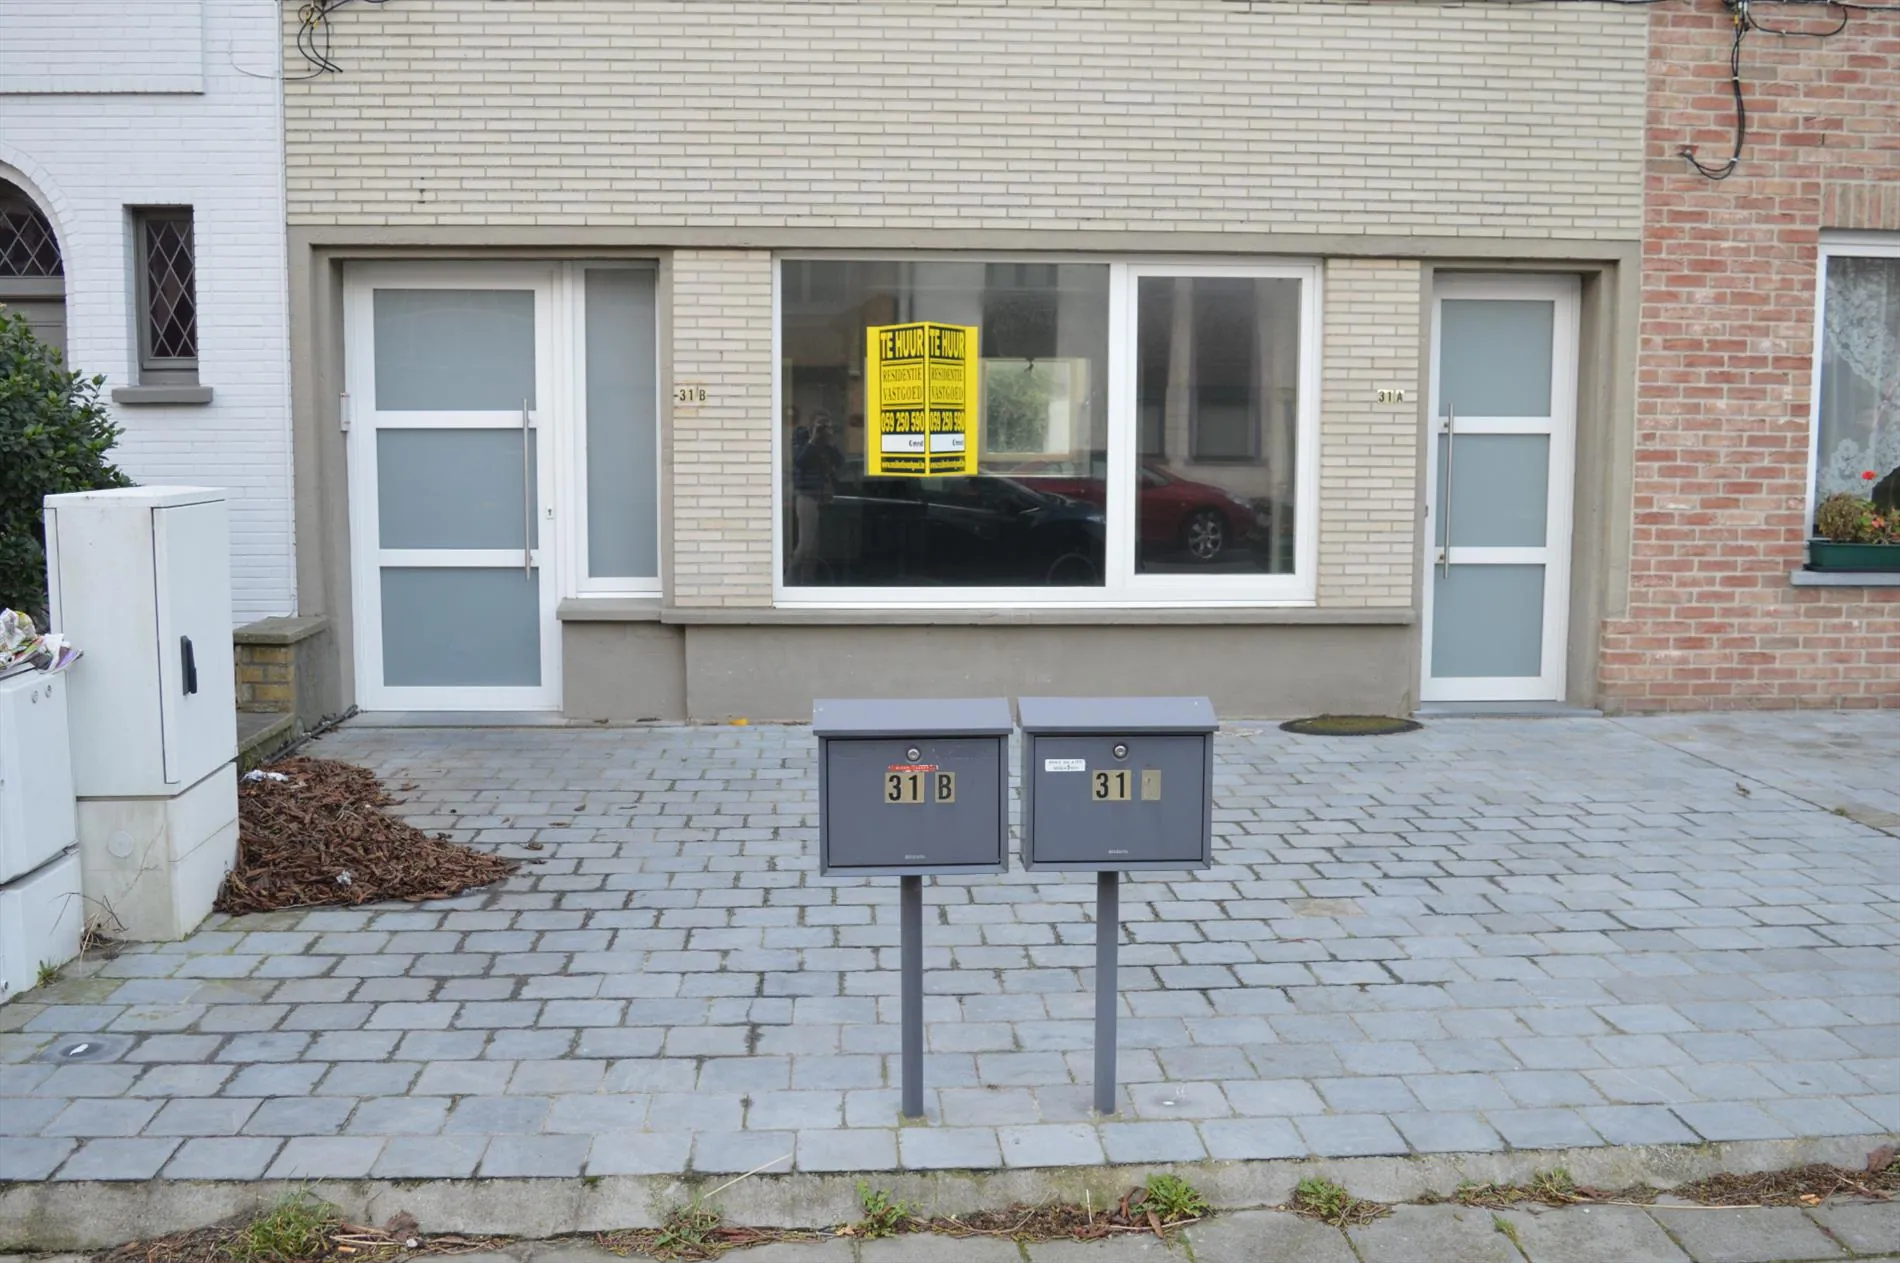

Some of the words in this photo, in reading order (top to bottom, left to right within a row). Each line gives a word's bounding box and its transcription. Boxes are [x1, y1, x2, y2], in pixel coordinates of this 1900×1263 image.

[881, 332, 894, 359] TE
[895, 328, 924, 358] HUUR
[930, 329, 941, 357] TE
[941, 331, 964, 359] HUUR
[882, 367, 922, 383] RESIDENTIE
[931, 367, 963, 382] RESIDENTIE
[679, 389, 692, 401] 31
[699, 389, 705, 401] B
[882, 385, 923, 402] VASTGOED
[931, 385, 964, 401] VASTGOED
[1379, 391, 1391, 402] 31
[1396, 391, 1403, 402] A
[881, 412, 894, 432] 059
[895, 412, 909, 432] 250
[910, 411, 925, 432] 590
[930, 411, 941, 432] 059
[941, 411, 953, 432] 250
[888, 775, 918, 801] 31
[938, 774, 952, 800] B
[1096, 772, 1125, 798] 31
